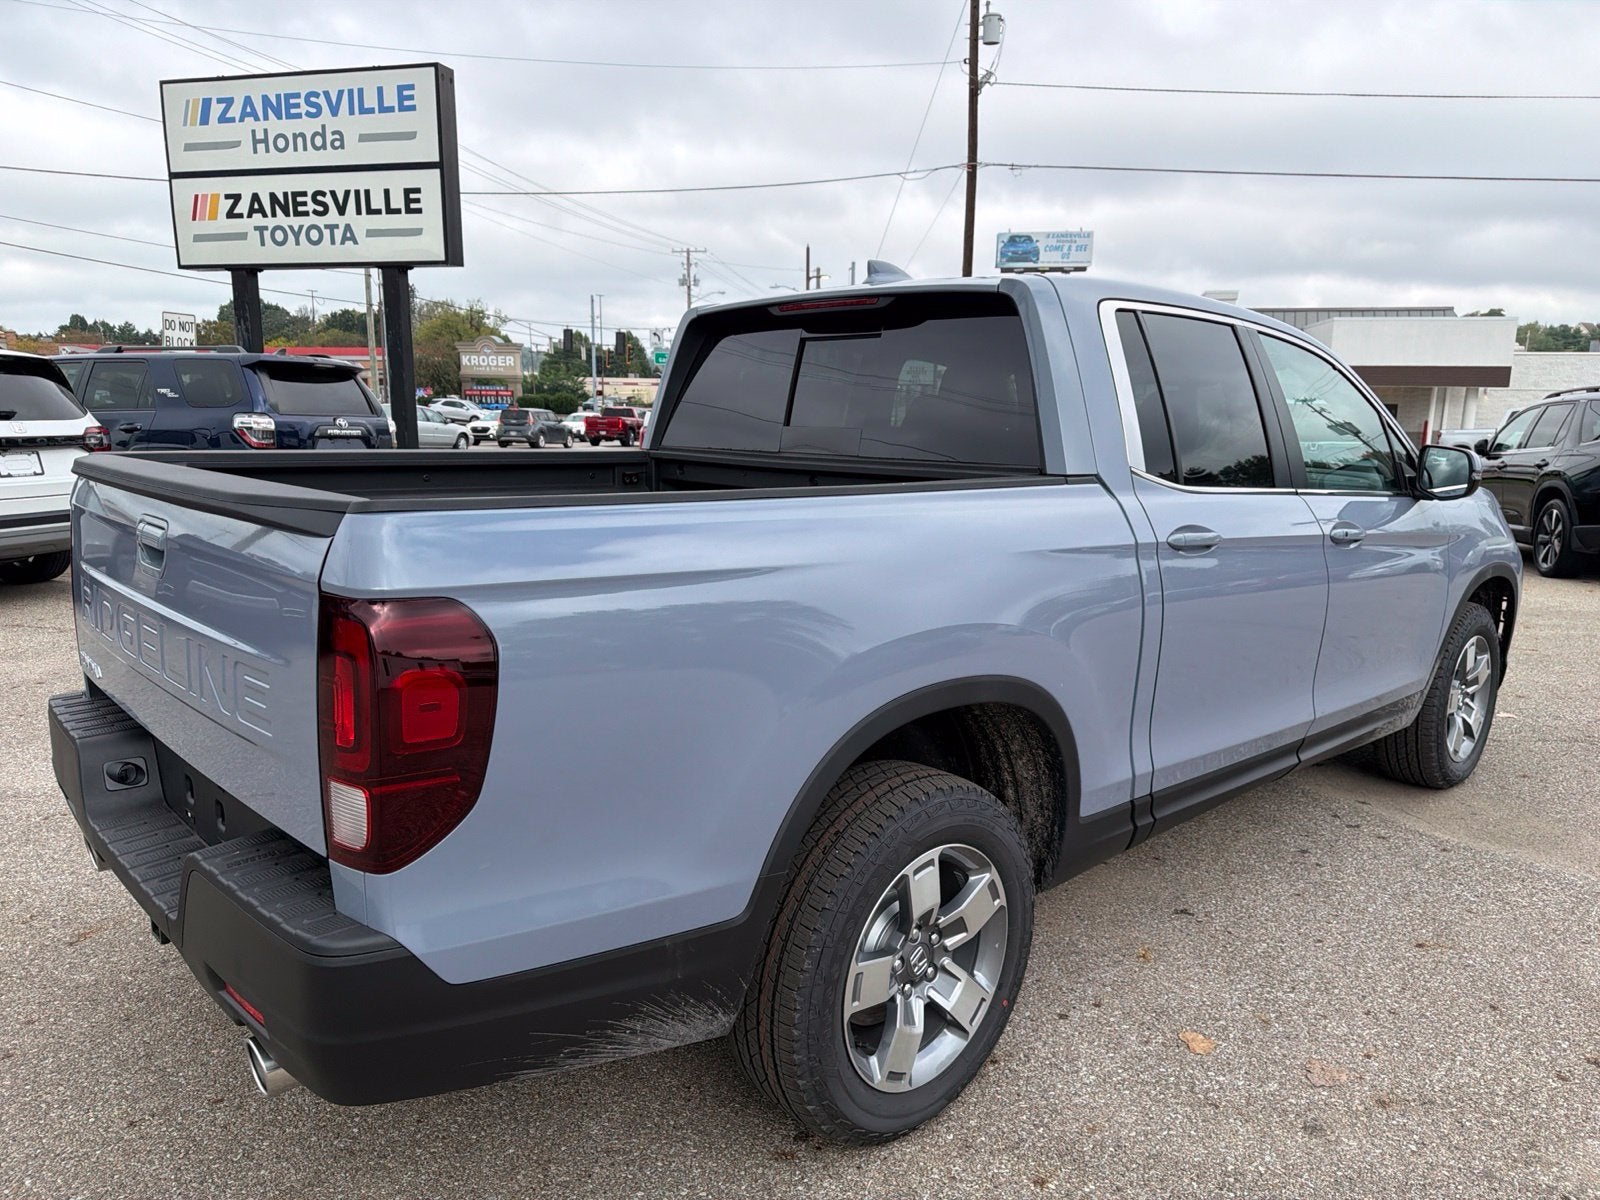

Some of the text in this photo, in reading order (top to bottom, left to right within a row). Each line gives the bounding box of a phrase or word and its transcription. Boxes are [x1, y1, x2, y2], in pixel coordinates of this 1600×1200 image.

[217, 83, 417, 124] ZANESVILLE
[251, 124, 345, 154] Honda
[224, 187, 423, 219] ZANESVILLE
[253, 223, 359, 247] TOYOTA
[1044, 244, 1064, 252] COME
[1075, 244, 1089, 252] SEE
[164, 319, 195, 333] DO NOT
[165, 335, 195, 347] BLOCK
[462, 355, 514, 366] KROGER
[80, 574, 273, 738] RIDGELINE
